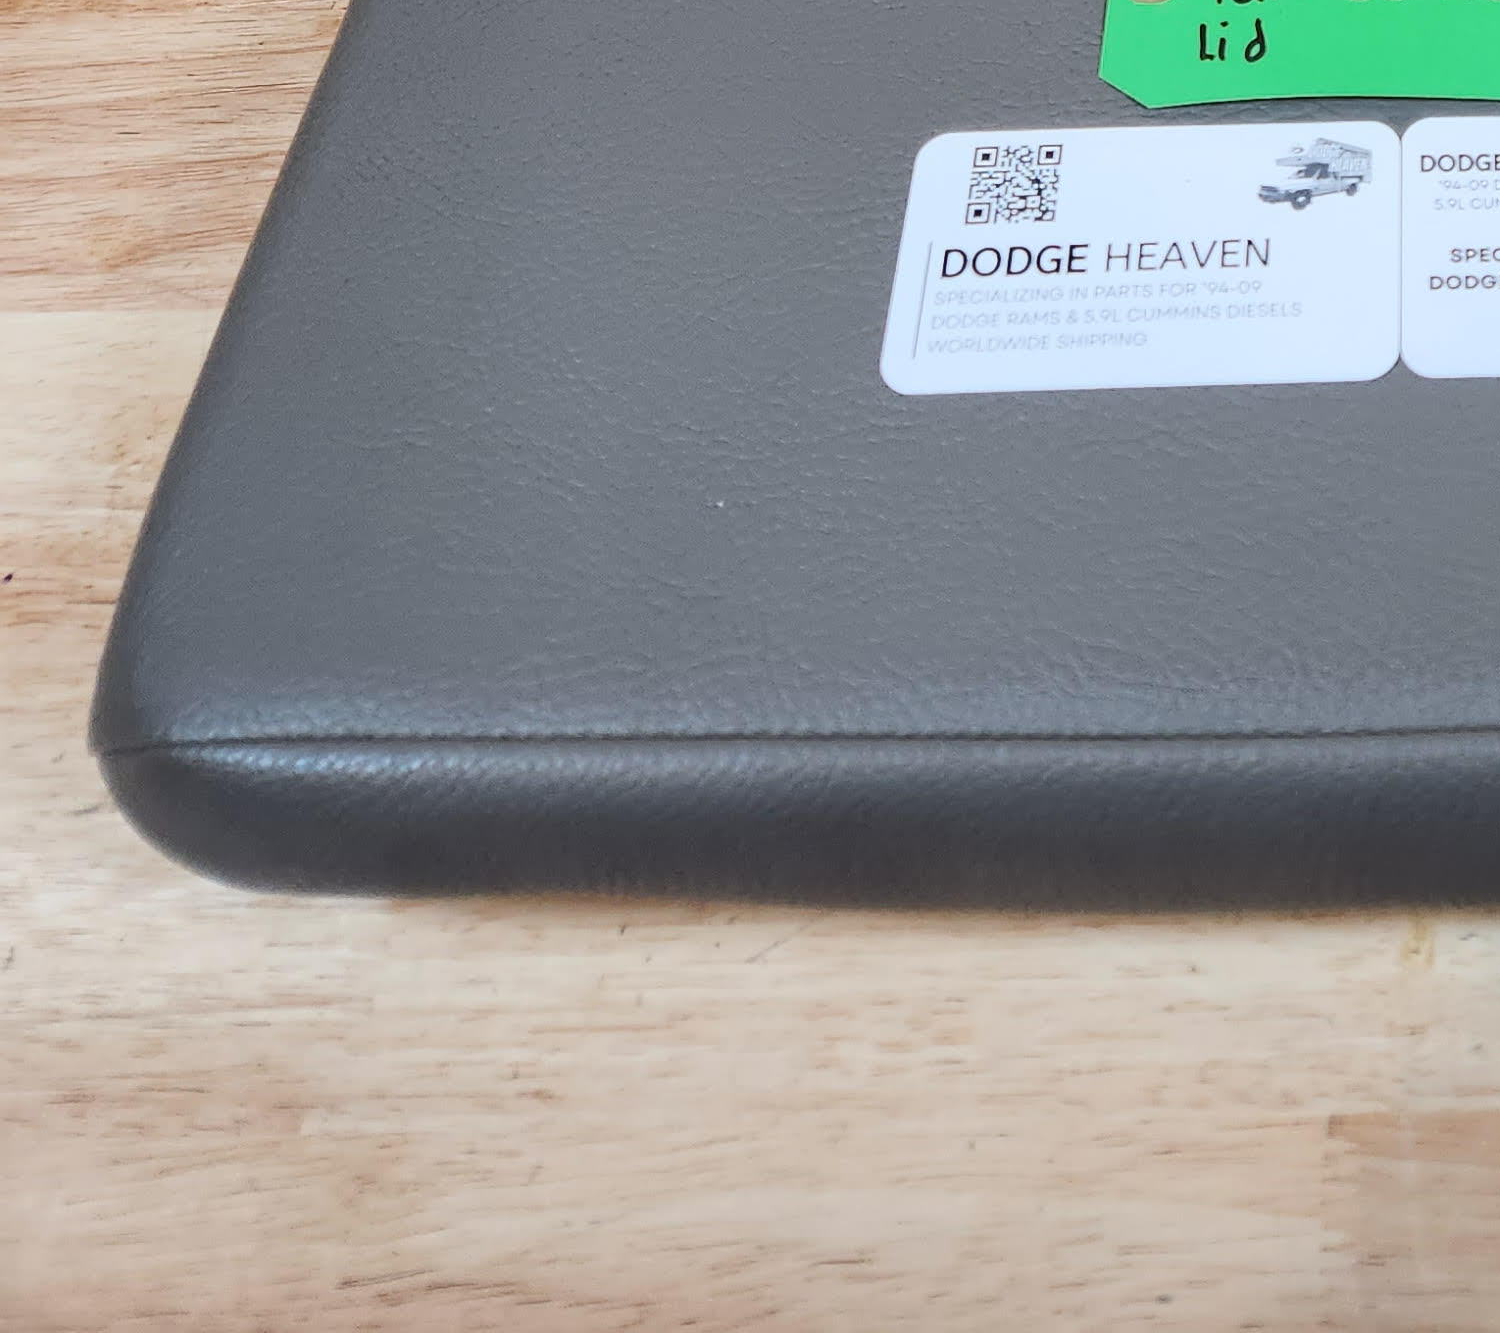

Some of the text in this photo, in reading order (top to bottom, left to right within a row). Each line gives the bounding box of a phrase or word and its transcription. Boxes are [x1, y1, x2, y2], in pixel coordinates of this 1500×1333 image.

[1199, 17, 1267, 63] Lid
[1434, 197, 1465, 211] 5.9L
[941, 238, 1270, 278] DODGE HEAVEN
[933, 285, 1065, 306] SPECIALIZING
[1069, 286, 1089, 301] IN
[1093, 284, 1154, 299] PARTS
[1159, 282, 1197, 298] FOR
[930, 301, 1303, 331] DODGE RAMS & 5.9L CUMMINS DIESELS
[927, 332, 1148, 354] WORLDWIDE SHIPPING
